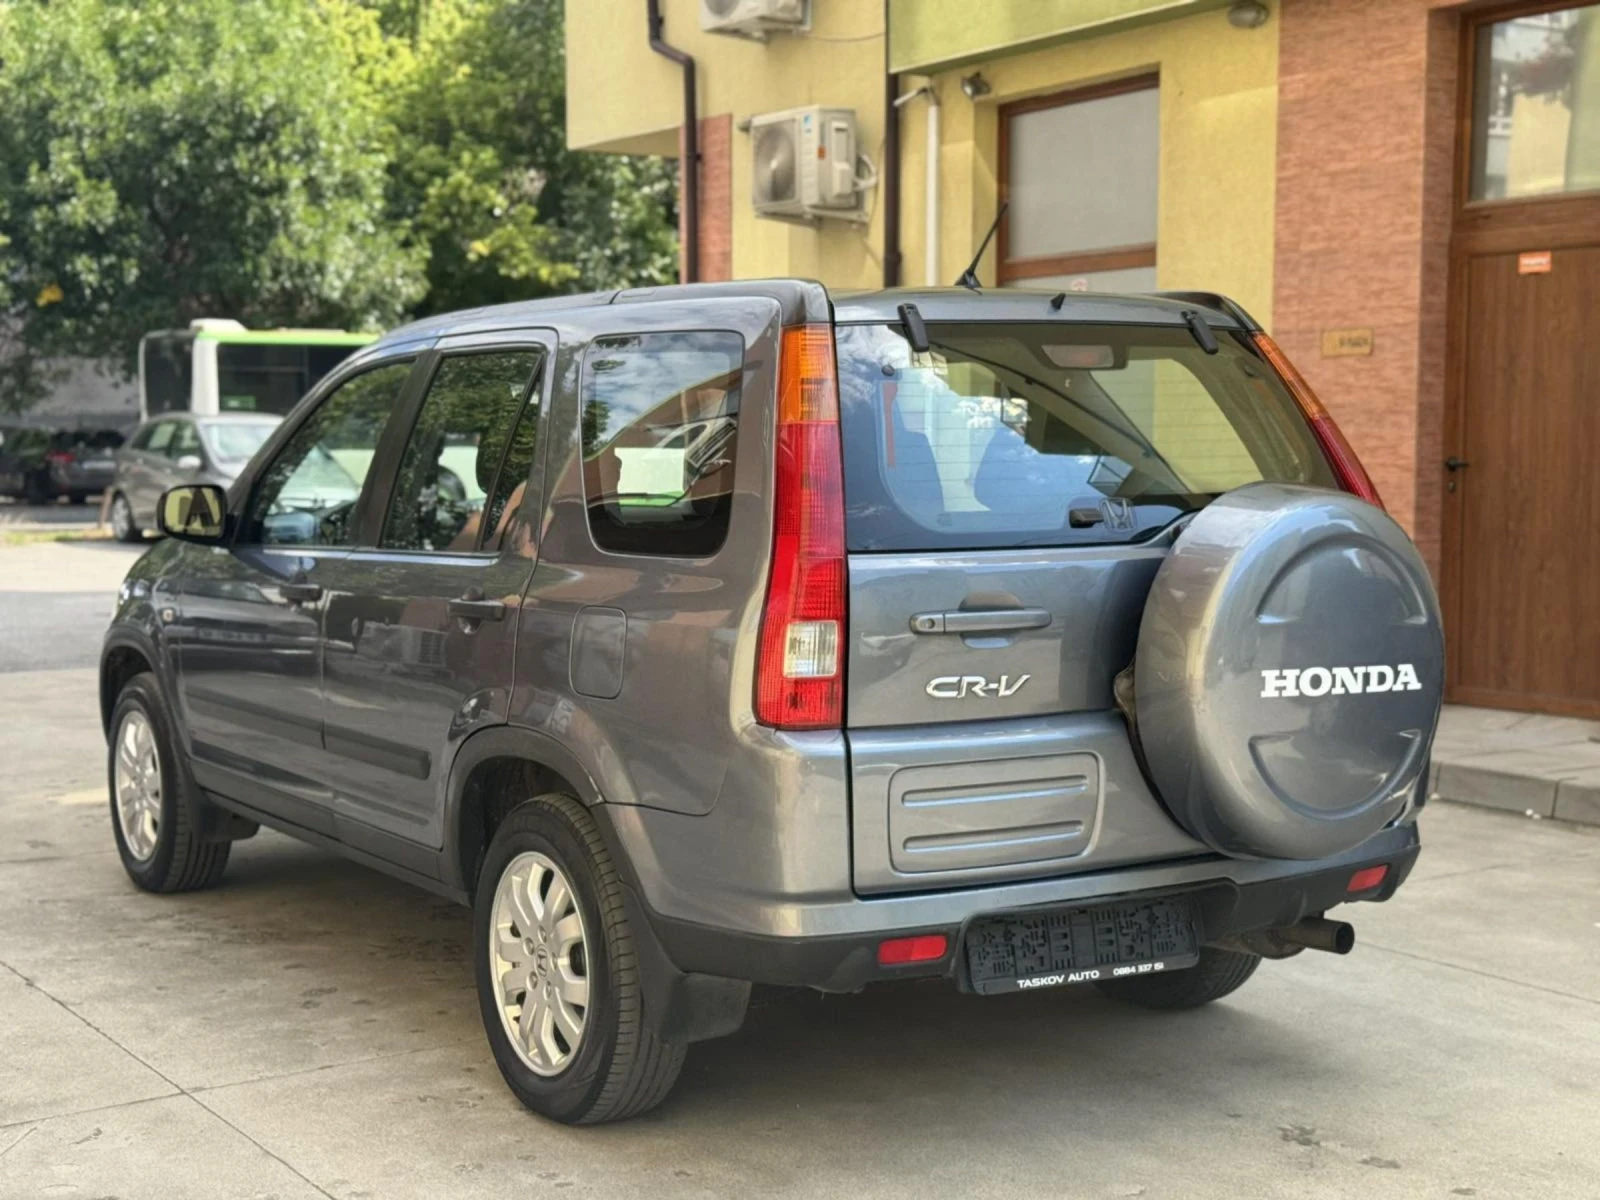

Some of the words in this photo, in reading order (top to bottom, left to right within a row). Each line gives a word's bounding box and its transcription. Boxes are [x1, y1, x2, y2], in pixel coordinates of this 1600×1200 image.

[925, 674, 1031, 698] CR-V
[1260, 663, 1423, 698] HONDA
[1016, 974, 1065, 989] TASKOV
[1067, 969, 1100, 982] AUTO
